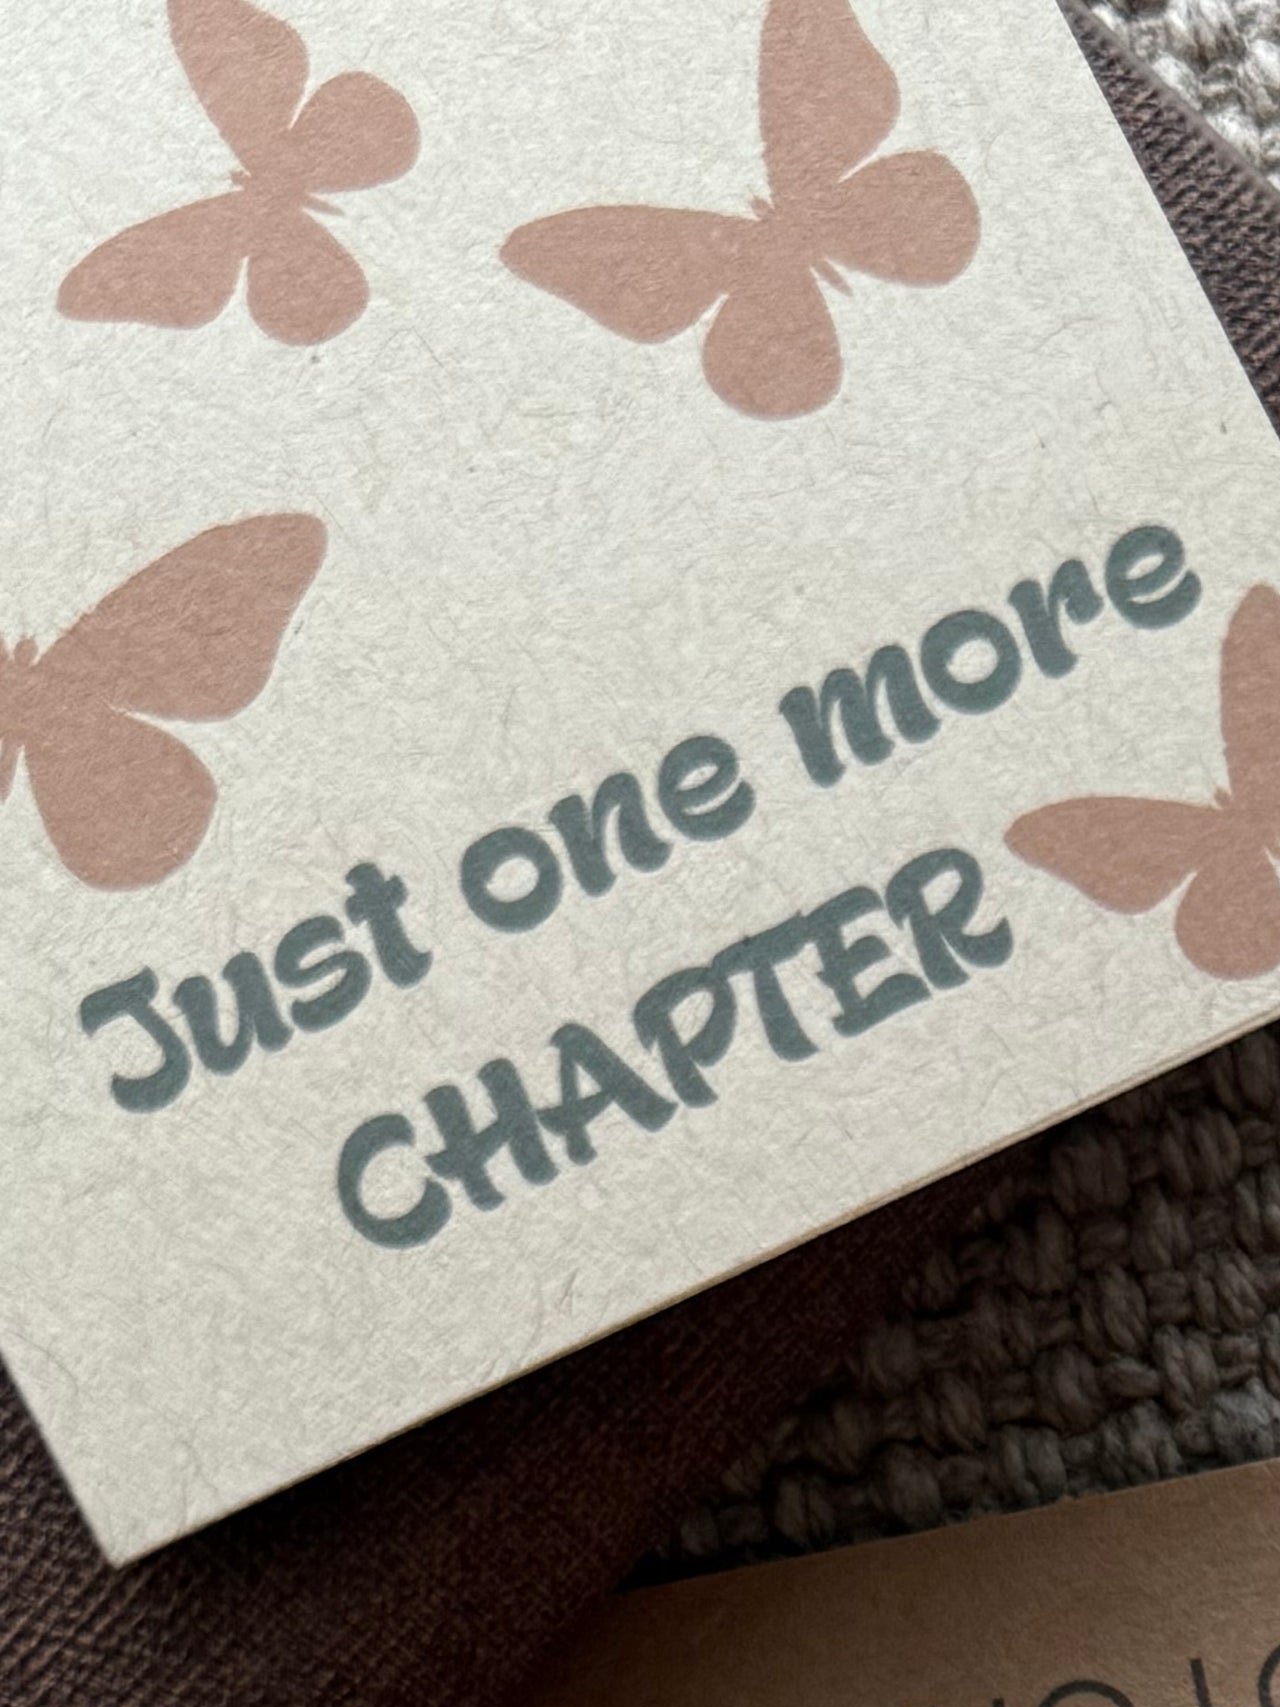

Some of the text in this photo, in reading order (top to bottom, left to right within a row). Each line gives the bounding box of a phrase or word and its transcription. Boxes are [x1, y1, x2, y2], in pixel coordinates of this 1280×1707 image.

[79, 522, 1201, 1115] Just one more
[336, 845, 1015, 1251] CHAPTER
